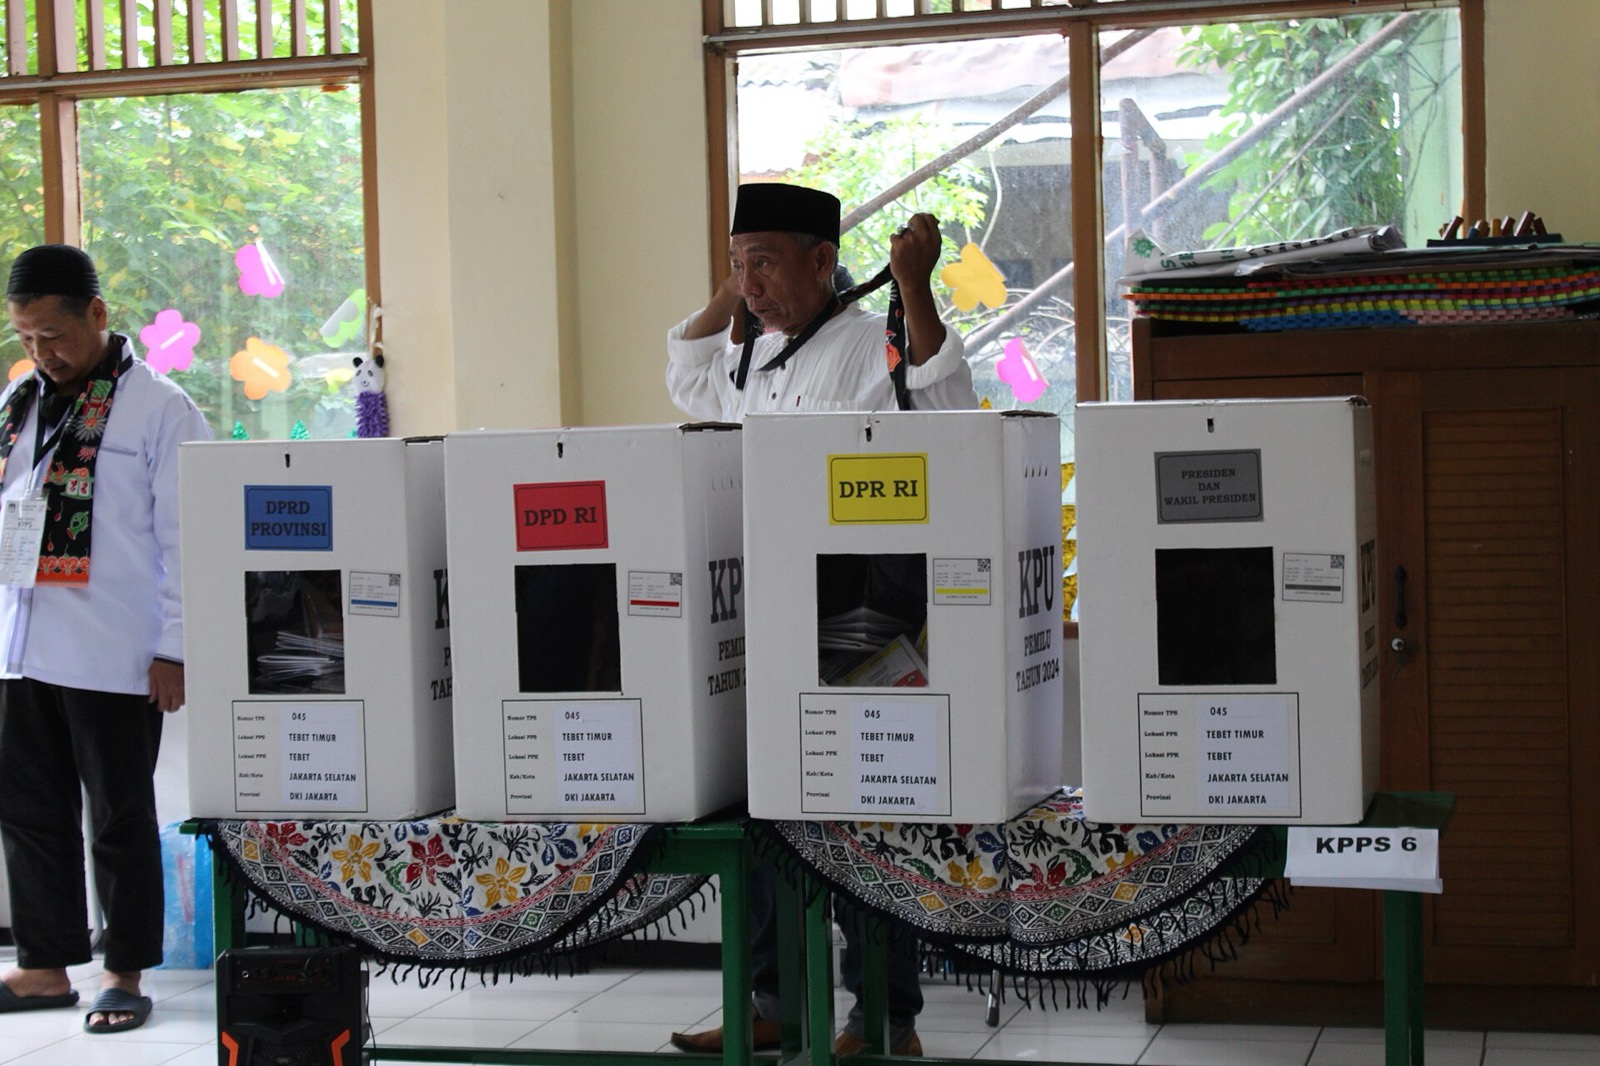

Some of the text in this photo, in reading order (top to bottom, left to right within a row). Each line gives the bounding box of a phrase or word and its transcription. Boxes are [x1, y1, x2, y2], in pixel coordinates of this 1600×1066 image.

[1181, 468, 1236, 480] PRESIDEN
[839, 480, 918, 498] DPR RI
[1198, 482, 1220, 492] DAN
[1164, 493, 1256, 506] WAKIL PRESIDEN
[265, 501, 310, 515] DPRD
[524, 506, 597, 527] DPD RI
[250, 522, 327, 537] PROVINSI
[1018, 545, 1055, 619] KPU
[708, 556, 744, 624] KP
[1024, 628, 1051, 657] PEMILU
[1016, 657, 1059, 693] TAHUN 2024
[708, 667, 740, 696] TAHUN
[292, 712, 306, 721] 045
[565, 711, 580, 720] 045
[864, 709, 881, 719] 045
[1210, 707, 1228, 716] 045
[288, 733, 336, 742] TEBET TIMUR
[562, 732, 612, 741] TEBET TIMUR
[861, 732, 915, 742] TEBET TIMUR
[1206, 730, 1264, 739] TEBET TIMUR
[289, 753, 310, 761] TEBET
[563, 753, 585, 761] TEBET
[861, 753, 884, 763] TEBET
[1207, 752, 1232, 761] TEBET
[289, 773, 356, 782] JAKARTA SELATAN
[564, 773, 635, 781] JAKARTA SELATAN
[860, 774, 937, 785] JAKARTA SELATAN
[1207, 773, 1289, 783] JAKARTA SELATAN
[290, 792, 338, 801] DKI JAKARTA
[565, 793, 616, 802] DKI JAKARTA
[861, 795, 916, 806] DKI JAKARTA
[1208, 795, 1267, 804] DKI JAKARTA
[1316, 837, 1417, 854] KPPS 6
